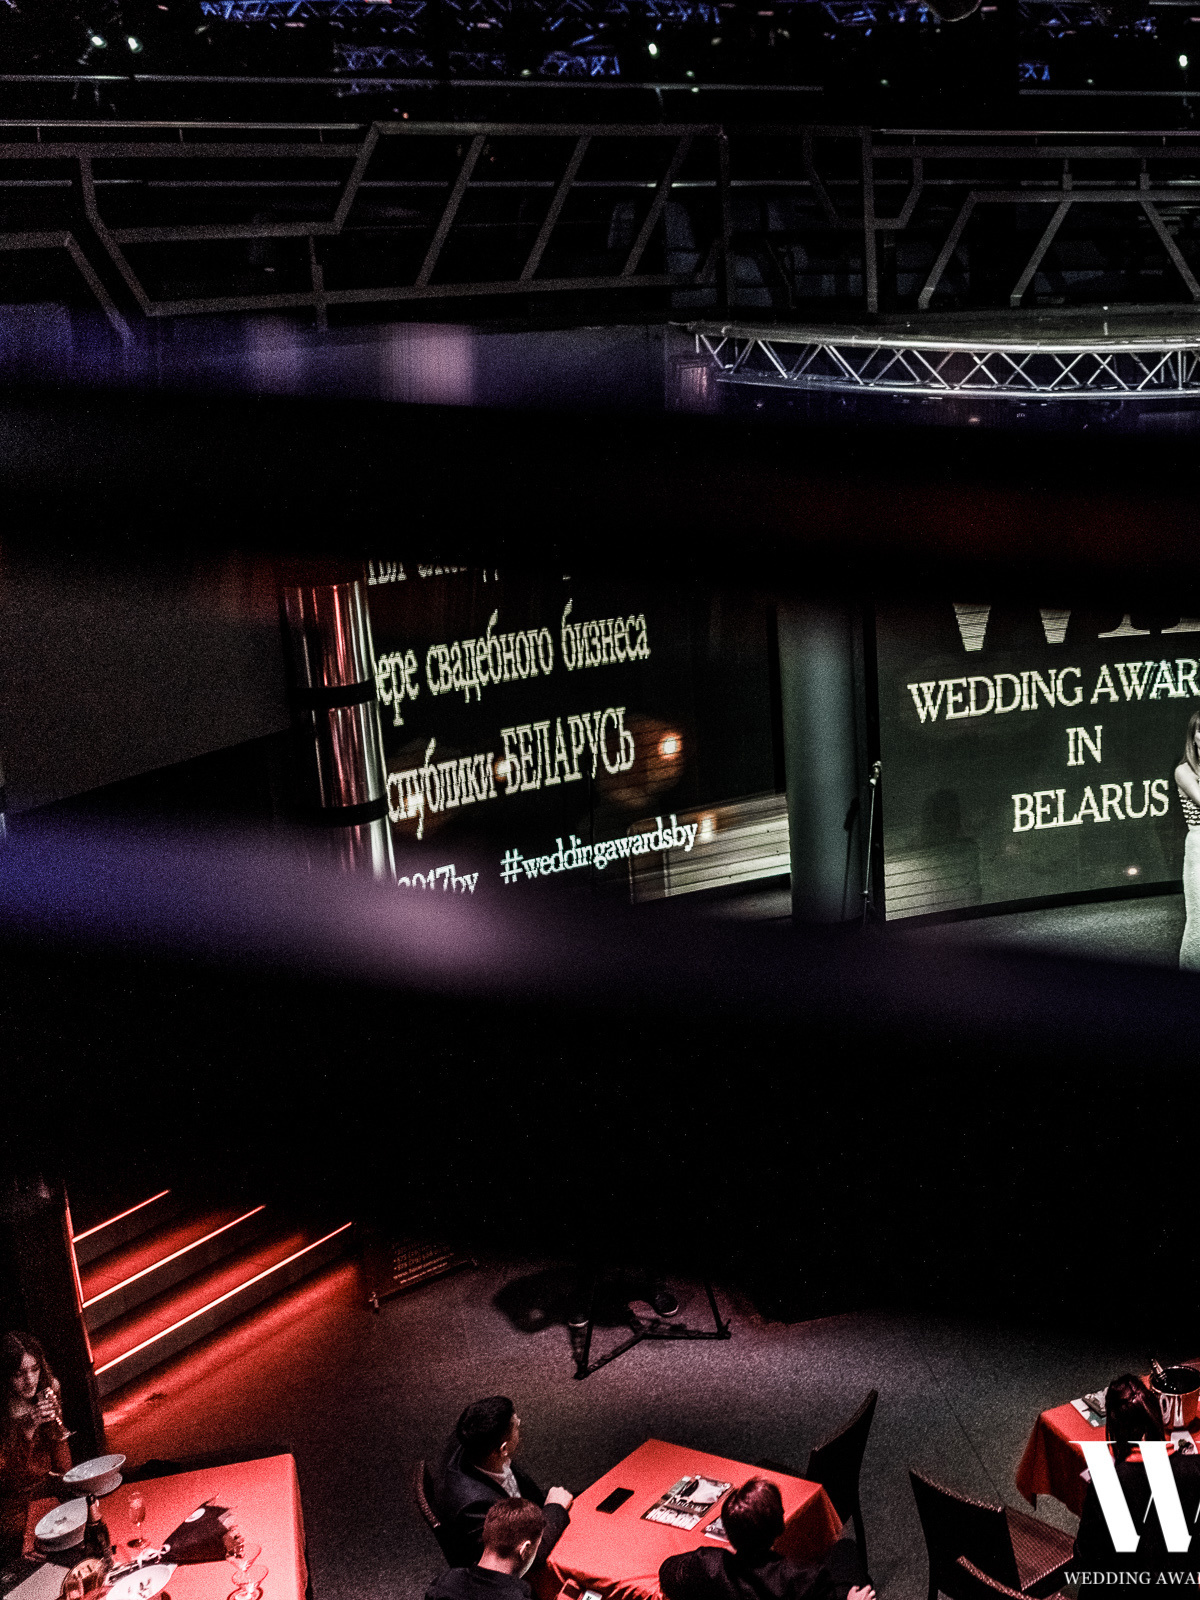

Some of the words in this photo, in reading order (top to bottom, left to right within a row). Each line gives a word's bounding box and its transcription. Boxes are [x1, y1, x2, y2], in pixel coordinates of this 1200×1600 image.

[376, 649, 419, 727] ере
[426, 609, 555, 704] свадебного
[561, 598, 652, 672] бизнеса
[907, 667, 1083, 724] WEDDING
[500, 707, 635, 795] БЕЛАРУСЬ
[1065, 725, 1103, 767] IN
[1012, 778, 1170, 833] BELARUS
[500, 814, 699, 884] #weddingawardsby
